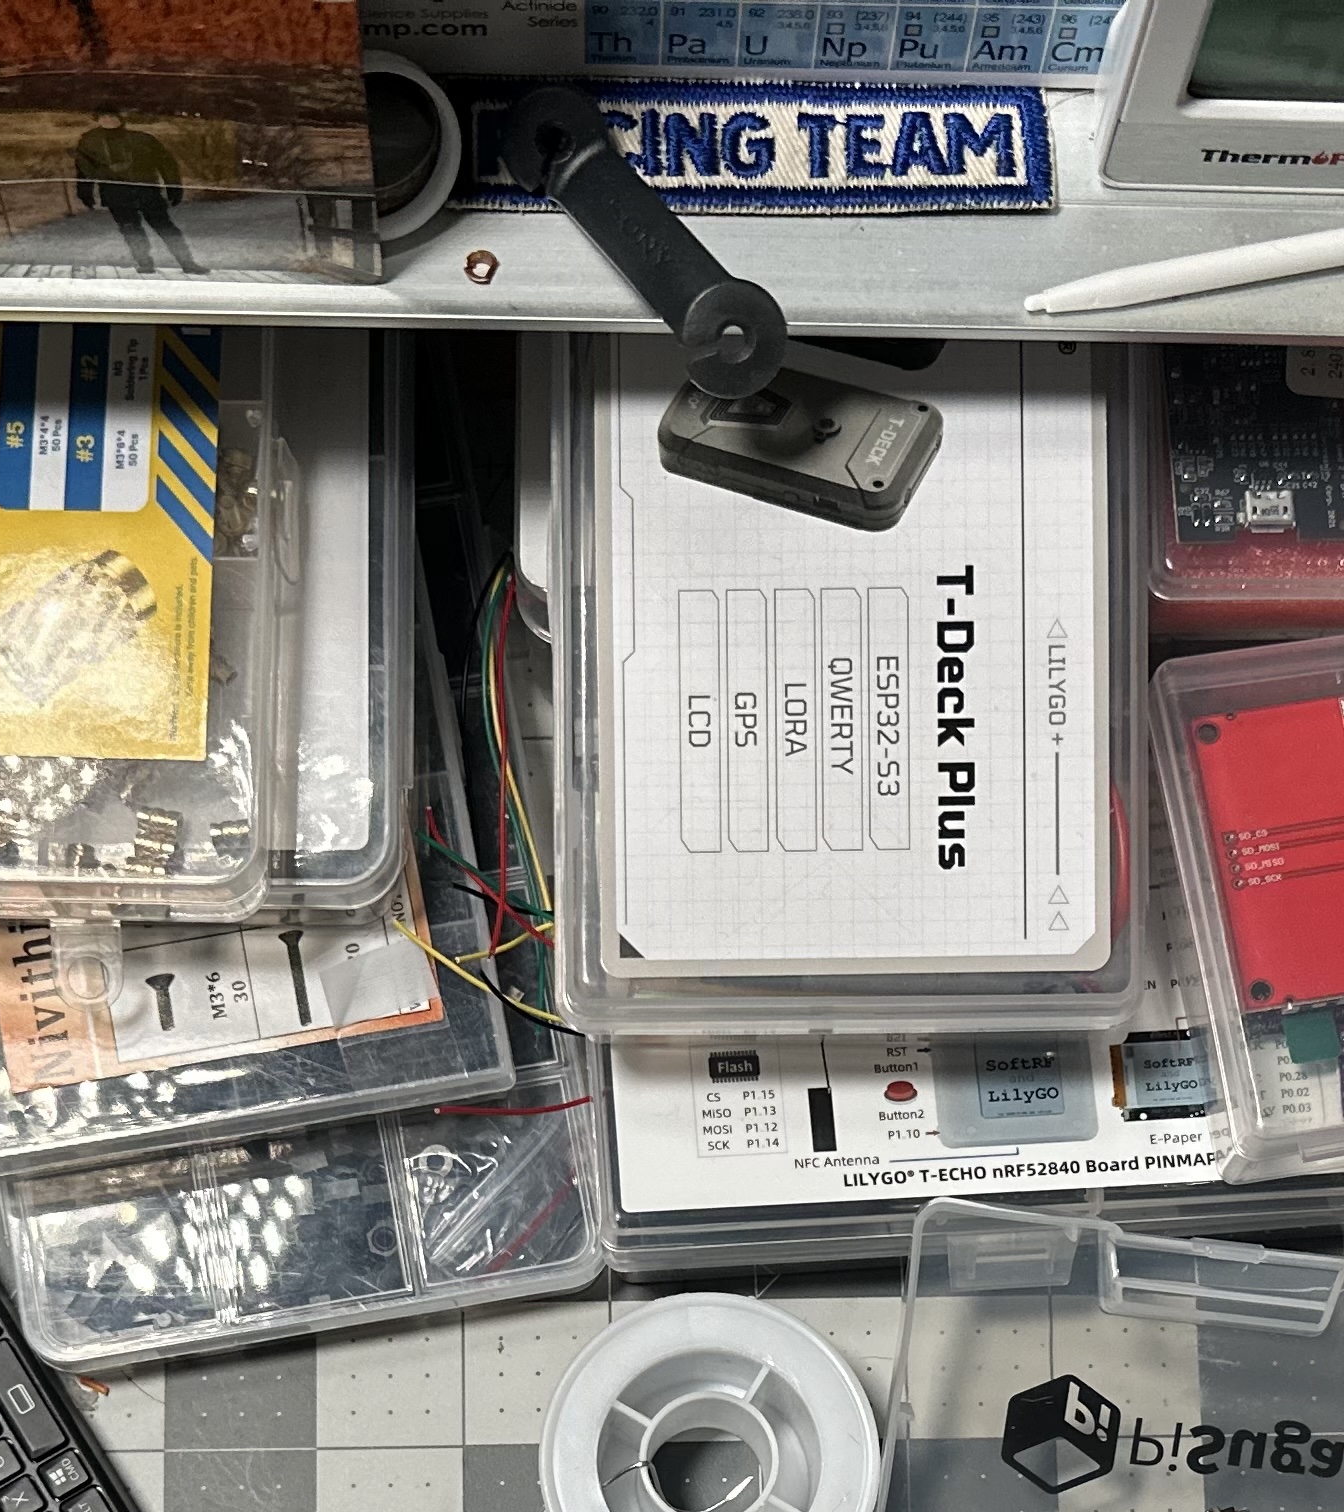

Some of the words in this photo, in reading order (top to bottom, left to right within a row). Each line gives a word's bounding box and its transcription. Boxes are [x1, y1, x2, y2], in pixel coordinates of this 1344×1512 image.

[364, 22, 488, 39] mp.com
[528, 16, 578, 28] Series
[590, 32, 633, 53] Th
[668, 33, 706, 54] Pa
[745, 35, 768, 56] U
[821, 37, 867, 62] Np
[899, 38, 938, 60] Pu
[973, 41, 1028, 62] Am
[1051, 42, 1104, 63] Cm
[798, 112, 1014, 179] TEAM
[6, 420, 25, 448] #5
[866, 417, 904, 466] T-DECK
[75, 434, 95, 463] #3
[937, 564, 975, 747] T-Deck
[1047, 643, 1067, 727] LILYGO
[688, 694, 711, 748] LCD
[734, 692, 758, 747] GPS
[784, 682, 808, 757] LORA
[827, 656, 854, 776] QWERTY
[876, 655, 901, 797] ESP32-S3
[937, 760, 976, 871] Plus
[233, 980, 249, 1003] 30
[886, 1046, 908, 1057] RST
[718, 1060, 753, 1074] Flash
[874, 1061, 919, 1074] Button1
[986, 1057, 1056, 1072] SoftRF
[1143, 1057, 1195, 1070] SoftRF
[743, 1089, 775, 1101] P1.15
[988, 1087, 1059, 1104] LilyGO
[1146, 1080, 1198, 1093] LilyGO
[744, 1106, 777, 1117] P1.13
[878, 1109, 925, 1122] Button2
[746, 1122, 778, 1134] P1.12
[888, 1129, 921, 1140] P1.10
[1150, 1131, 1203, 1146] E-Paper
[707, 1140, 730, 1151] SCK
[746, 1137, 780, 1149] P1.14
[794, 1158, 820, 1169] NFC
[824, 1155, 880, 1168] Antenna
[920, 1166, 987, 1184] T-ECHO
[992, 1160, 1081, 1179] nRF52840
[1086, 1155, 1139, 1173] Board
